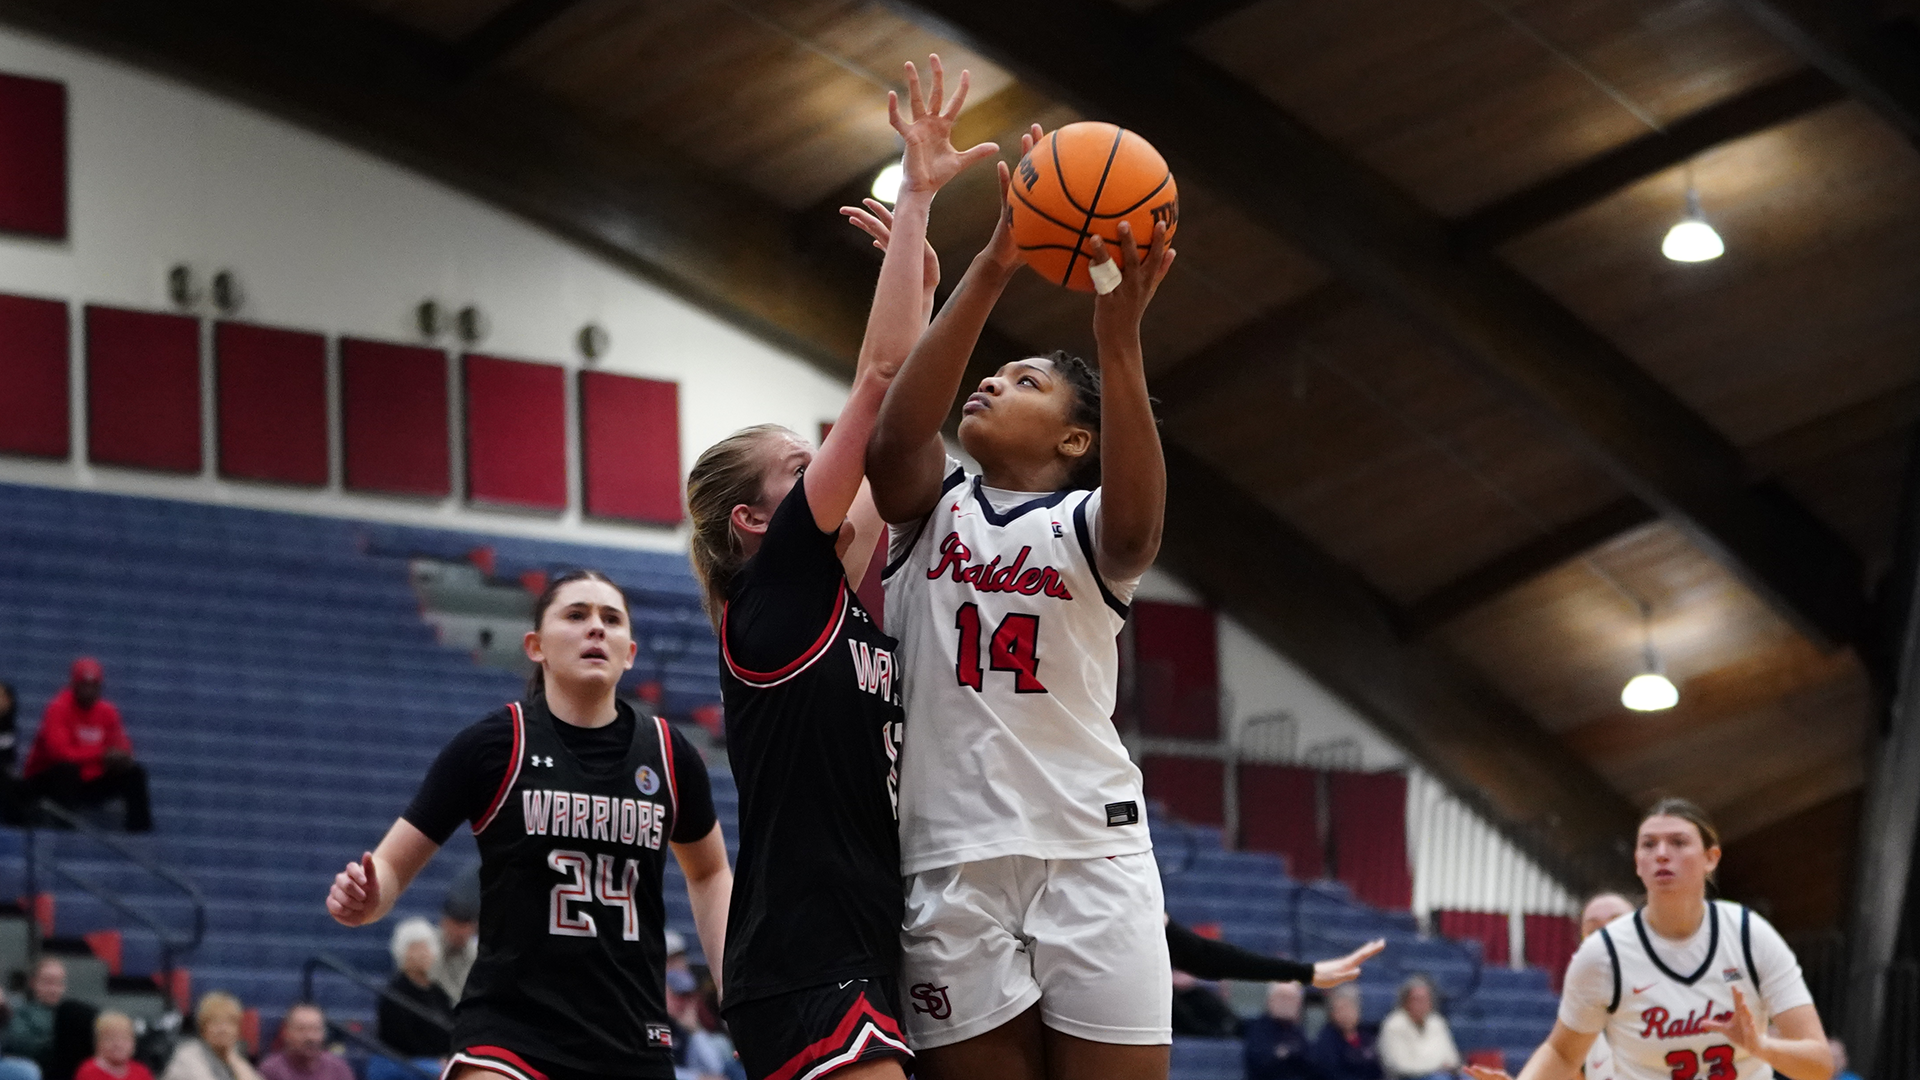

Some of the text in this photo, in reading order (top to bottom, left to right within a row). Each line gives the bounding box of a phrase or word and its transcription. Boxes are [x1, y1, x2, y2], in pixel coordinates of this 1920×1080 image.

[955, 601, 1049, 694] 14
[522, 790, 665, 850] WARRIORS
[547, 849, 640, 941] 24
